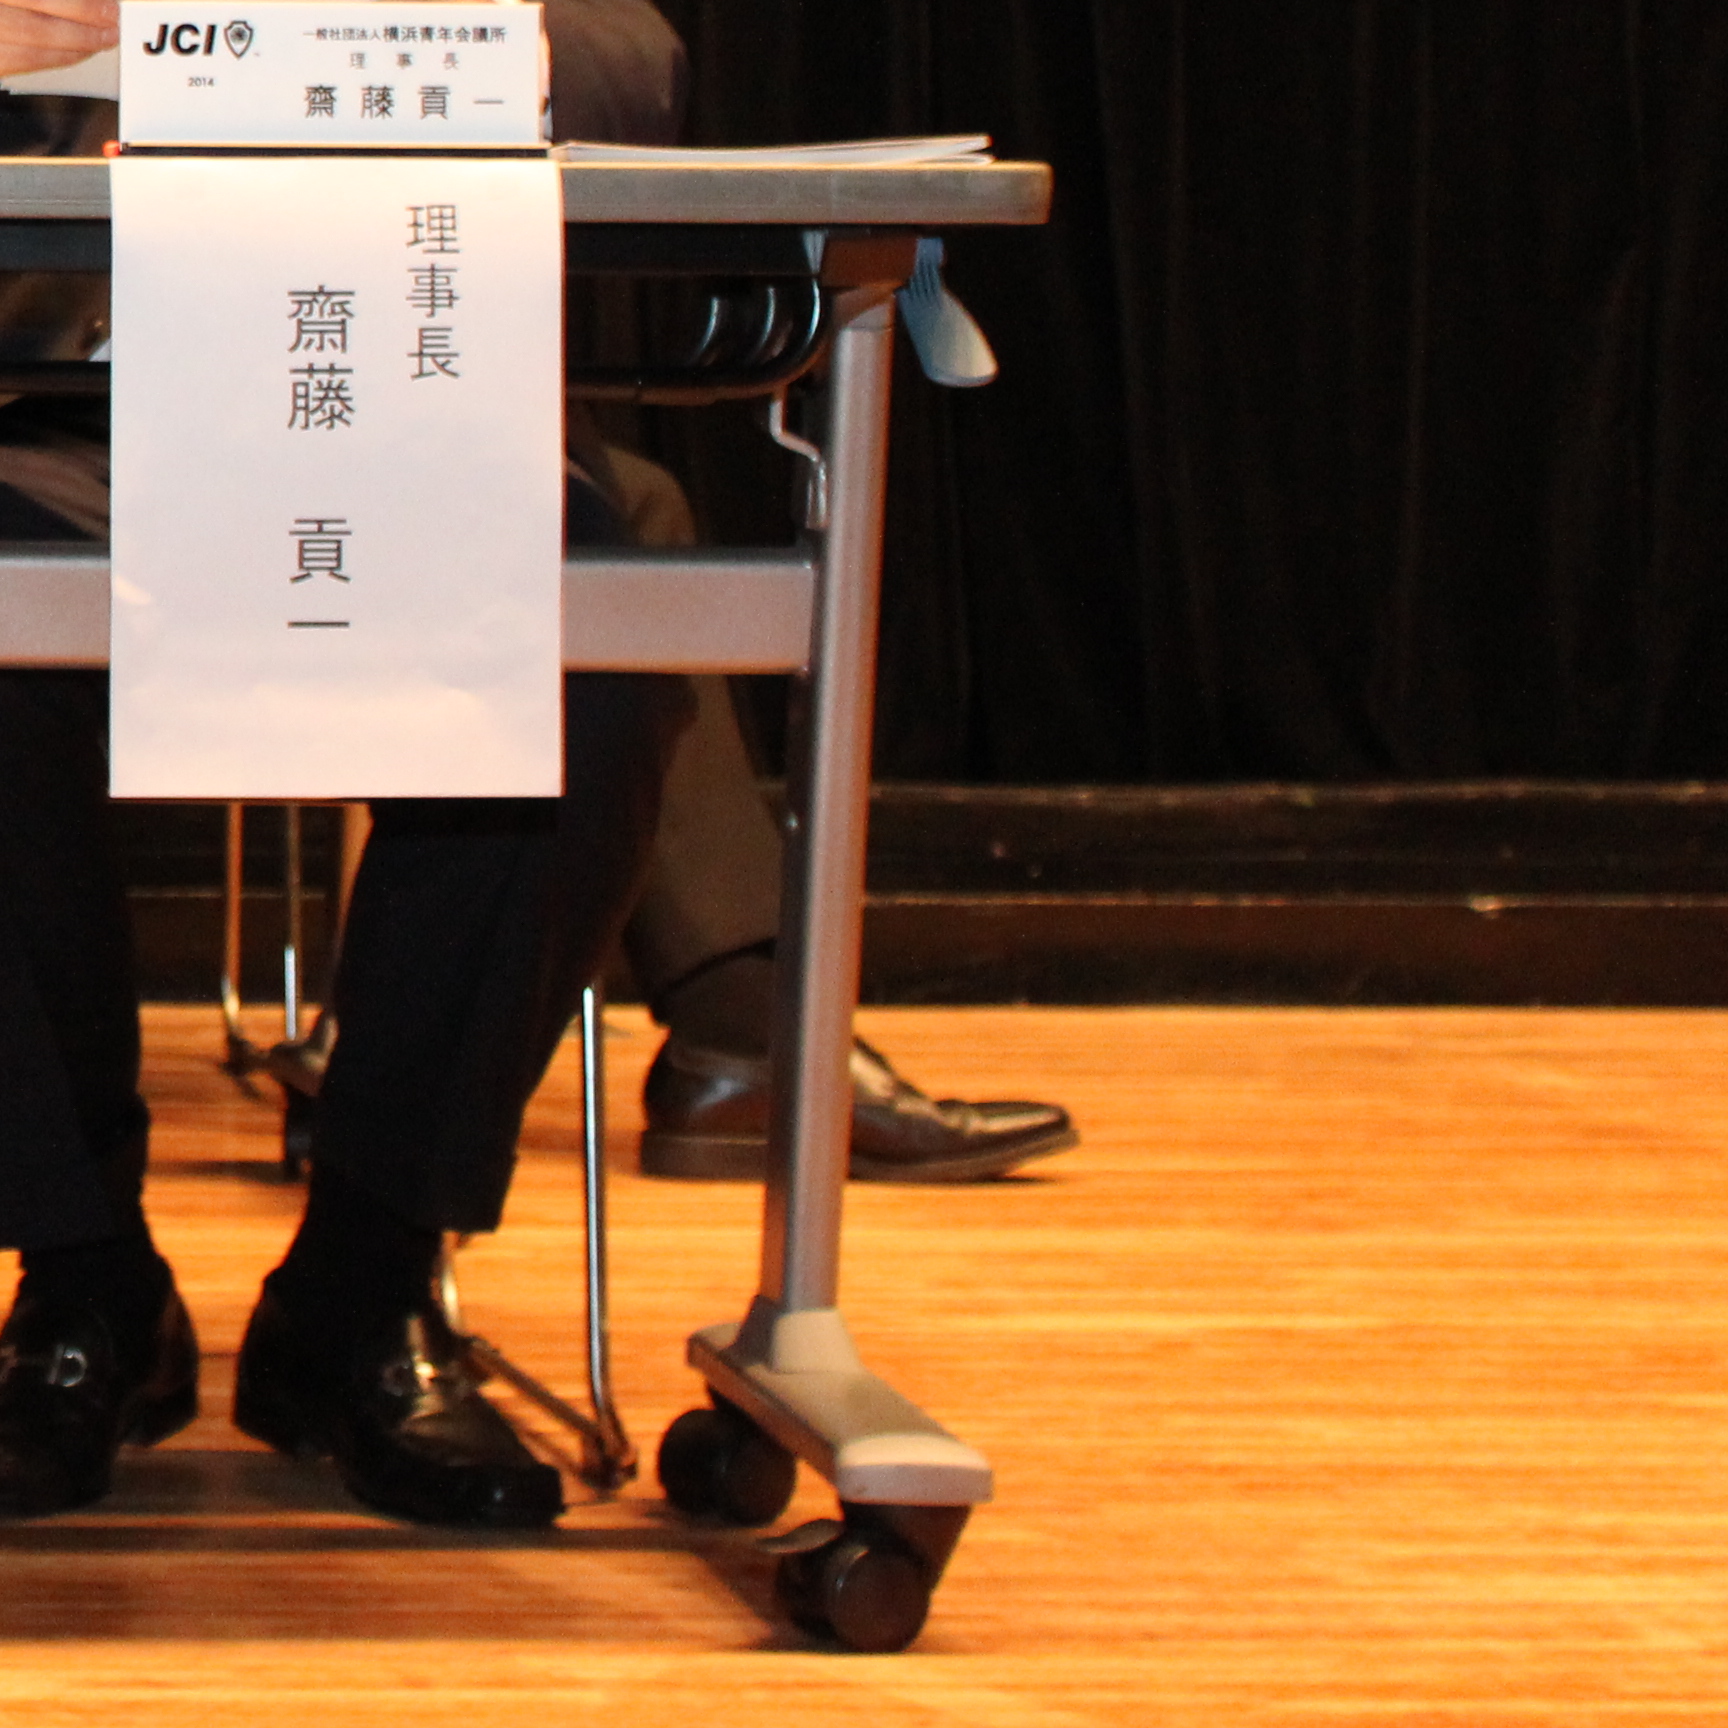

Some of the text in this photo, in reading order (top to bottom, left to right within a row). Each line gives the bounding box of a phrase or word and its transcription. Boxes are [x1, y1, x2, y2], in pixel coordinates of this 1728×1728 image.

[143, 23, 217, 57] JCI
[349, 52, 461, 71] 理事長
[187, 76, 216, 89] 2014
[405, 203, 462, 381] 理事長
[287, 517, 354, 630] 貢一
